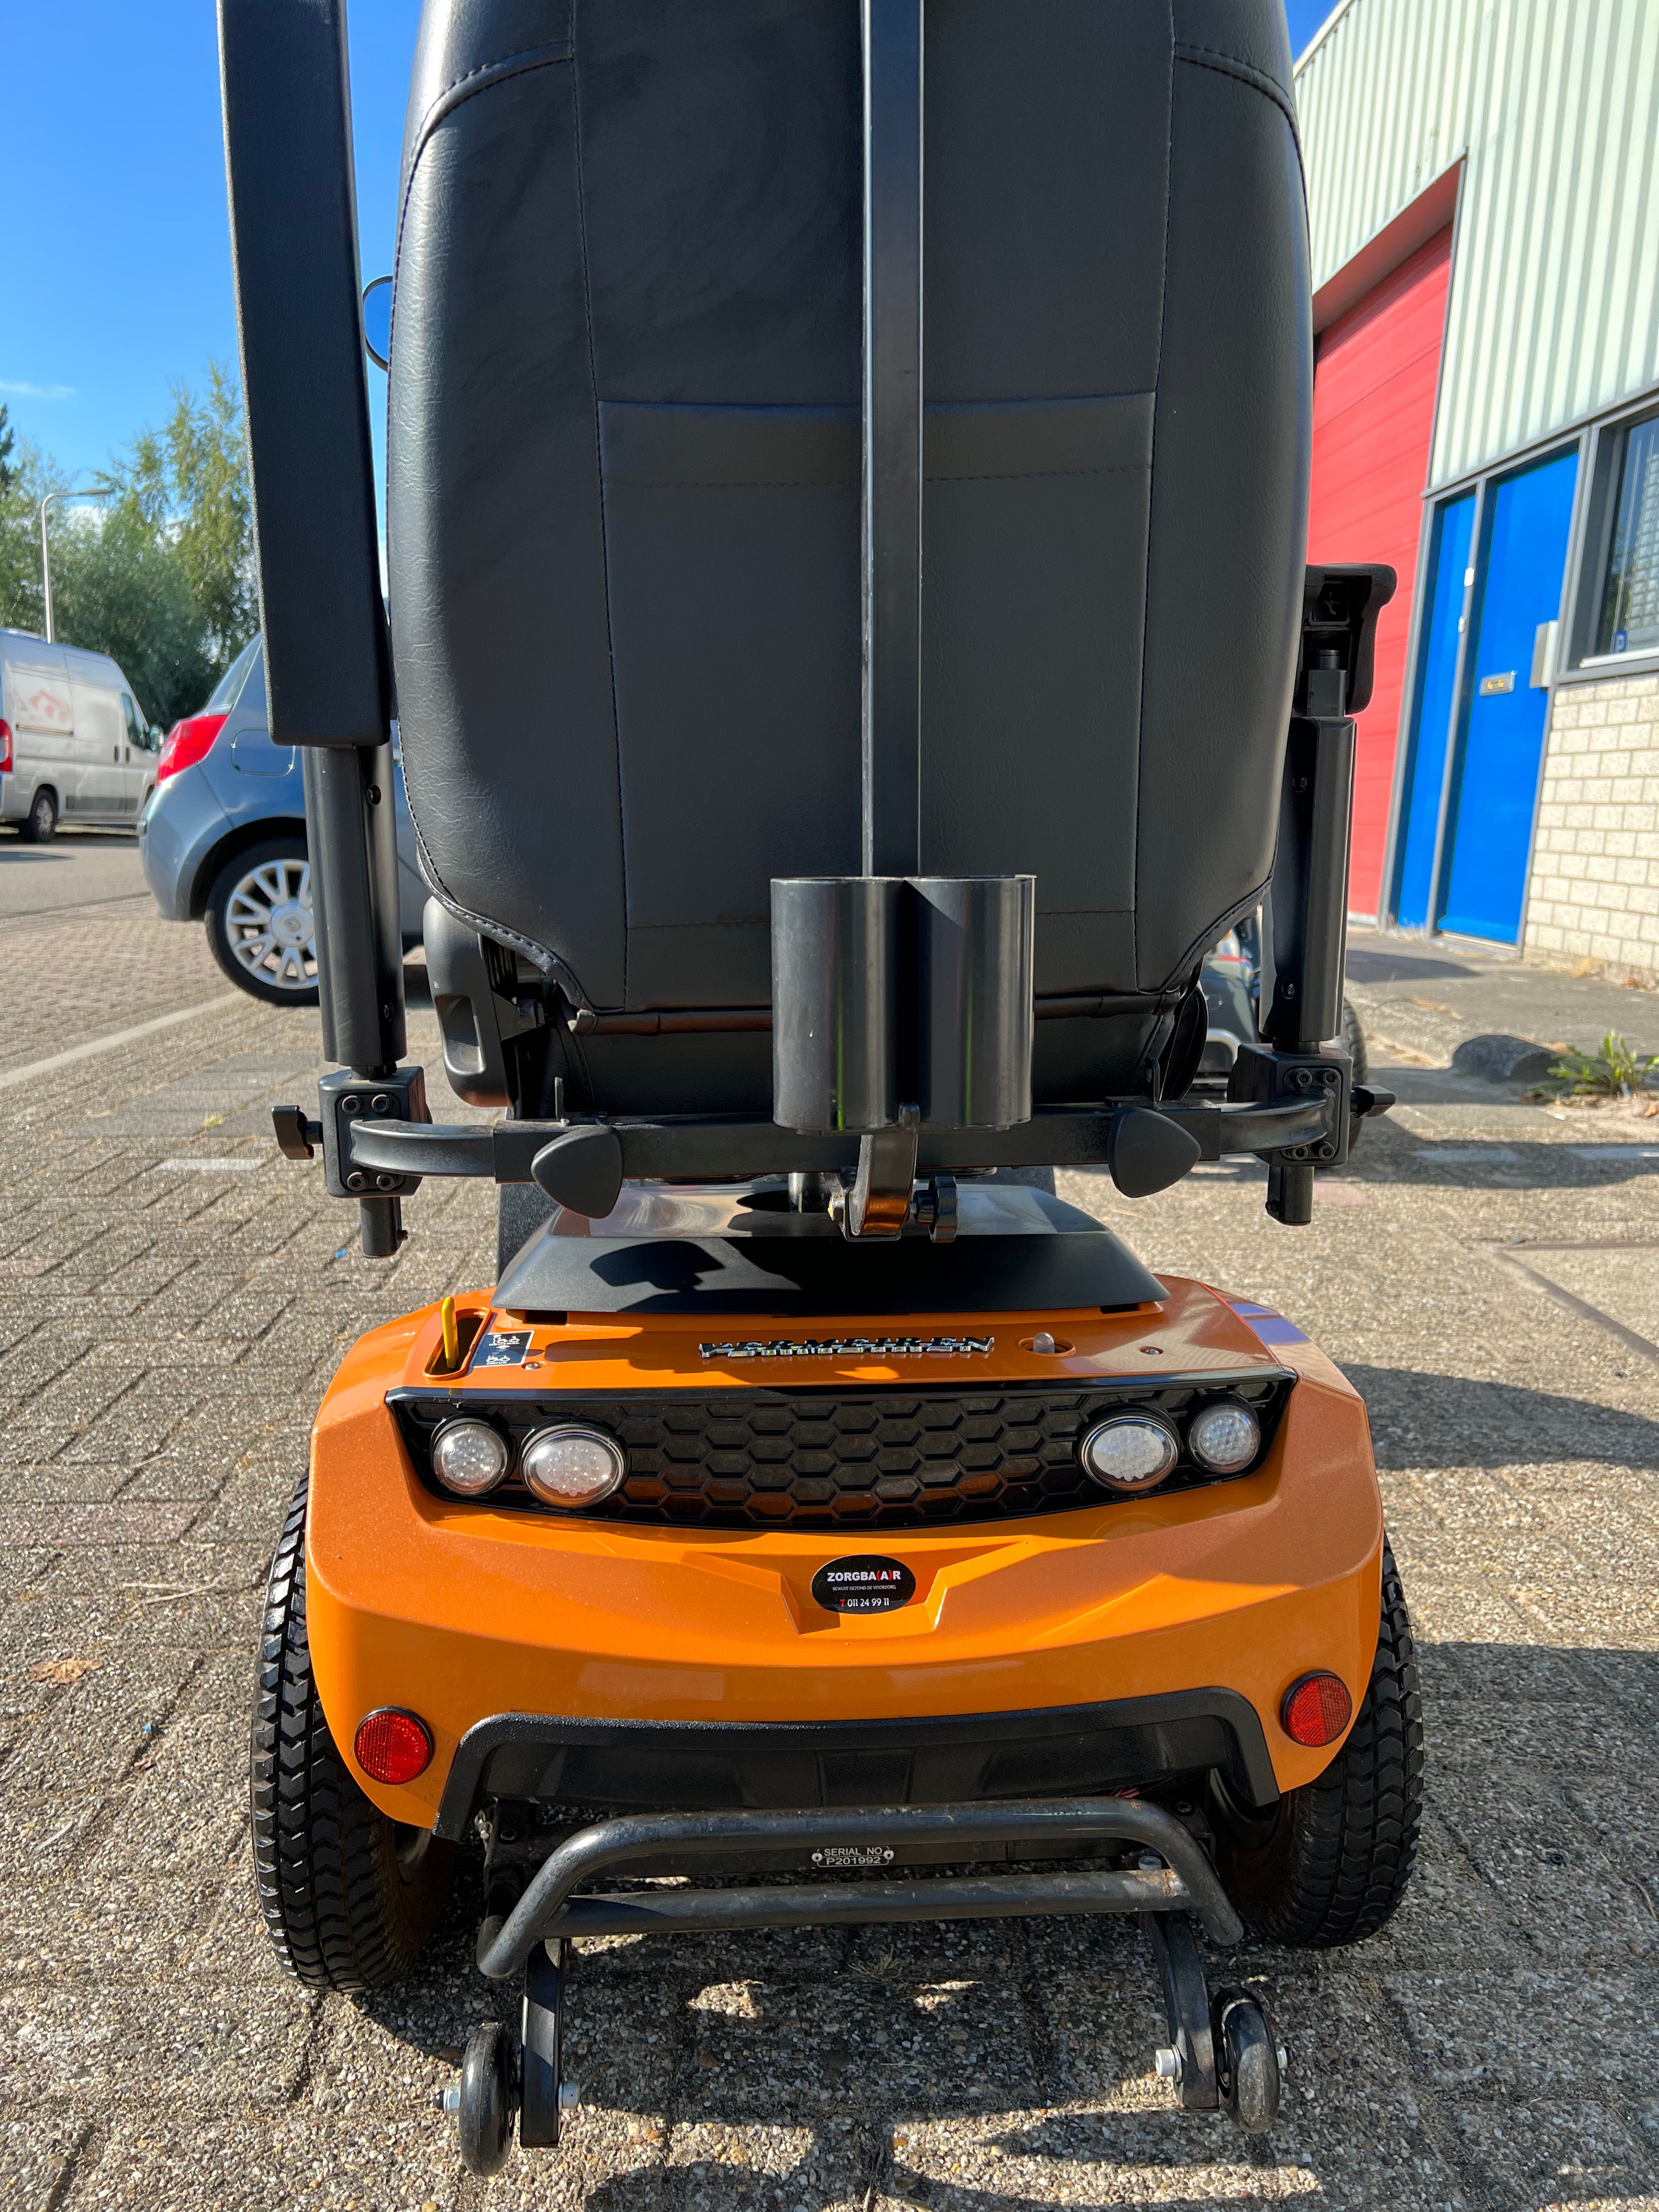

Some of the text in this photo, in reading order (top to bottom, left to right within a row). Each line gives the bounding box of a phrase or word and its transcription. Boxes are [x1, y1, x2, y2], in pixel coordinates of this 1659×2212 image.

[698, 1336, 995, 1358] VERMEIREN
[827, 1570, 901, 1582] ZORGBA(A)R
[847, 1599, 858, 1607] 011
[860, 1598, 870, 1607] 24
[871, 1598, 882, 1606] 99
[883, 1598, 889, 1606] 11
[823, 1847, 883, 1856] SERIAL NO
[826, 1857, 881, 1865] P201992
